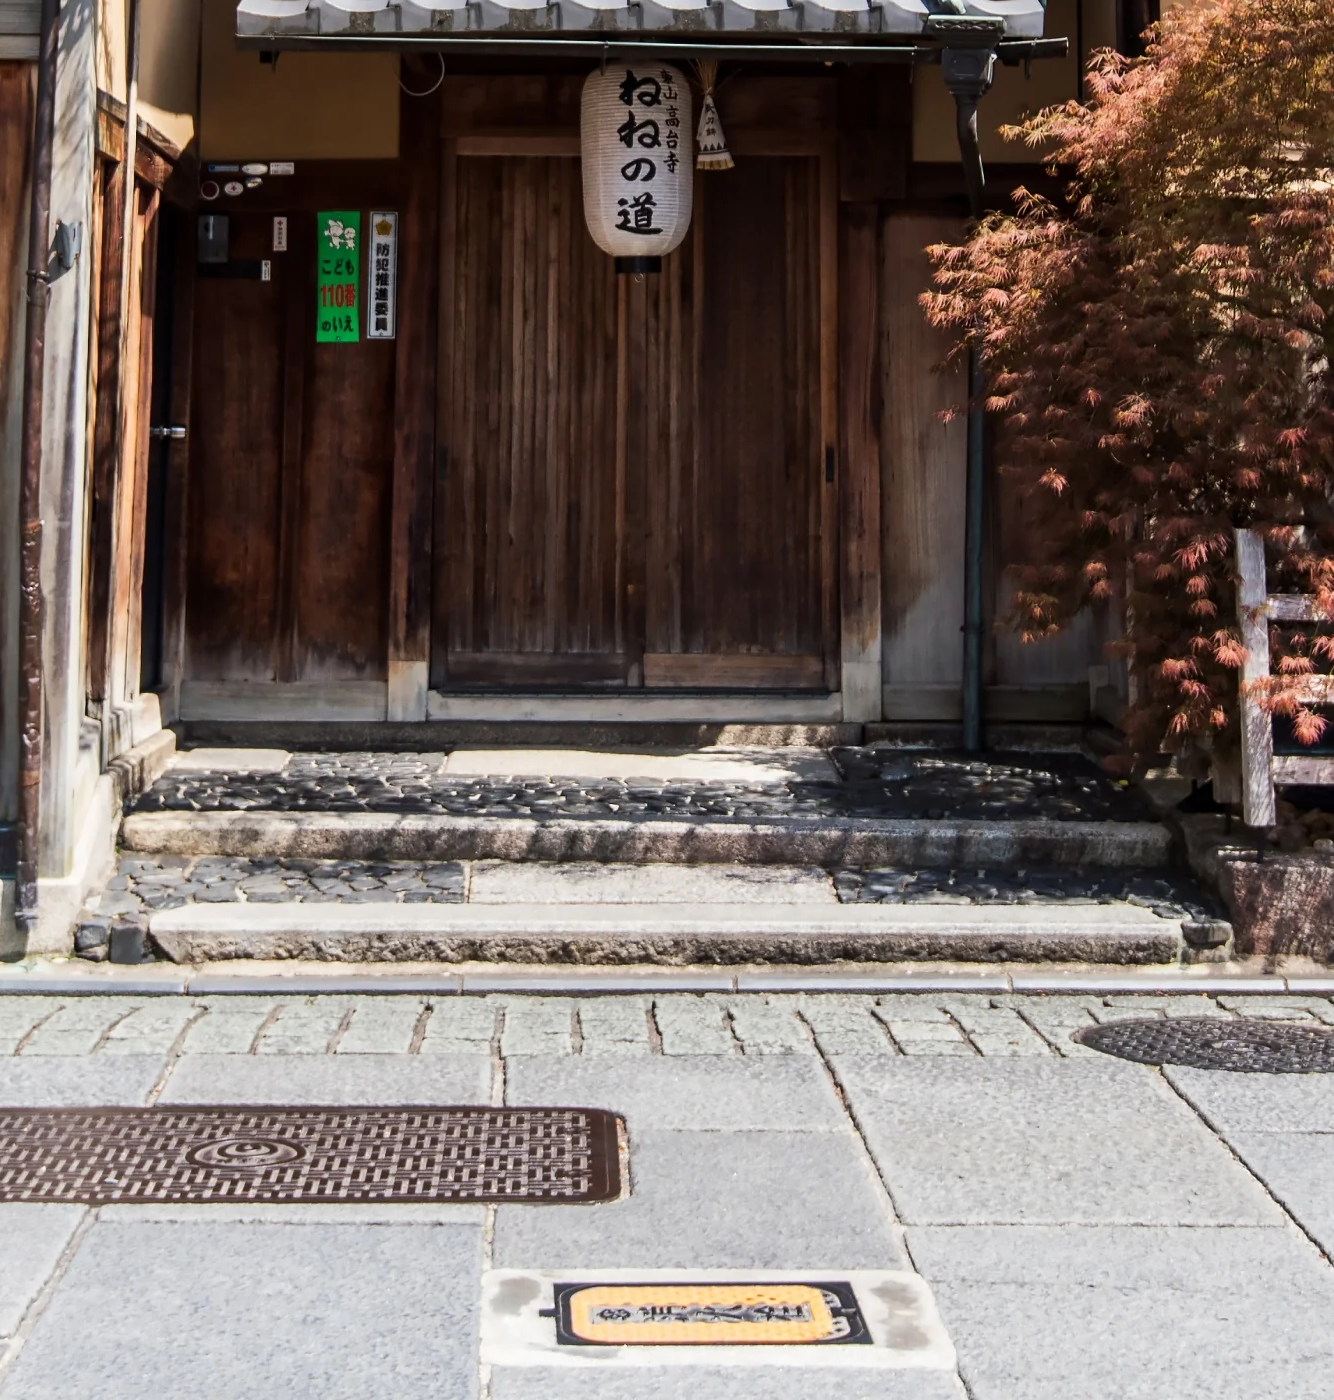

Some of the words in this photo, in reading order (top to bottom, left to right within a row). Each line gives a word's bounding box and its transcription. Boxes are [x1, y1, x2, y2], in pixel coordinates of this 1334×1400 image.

[615, 69, 663, 235] ねねの道
[322, 258, 355, 275] こども
[320, 284, 356, 308] 110番
[375, 242, 391, 332] 防犯推進委員
[322, 315, 354, 332] のいえ
